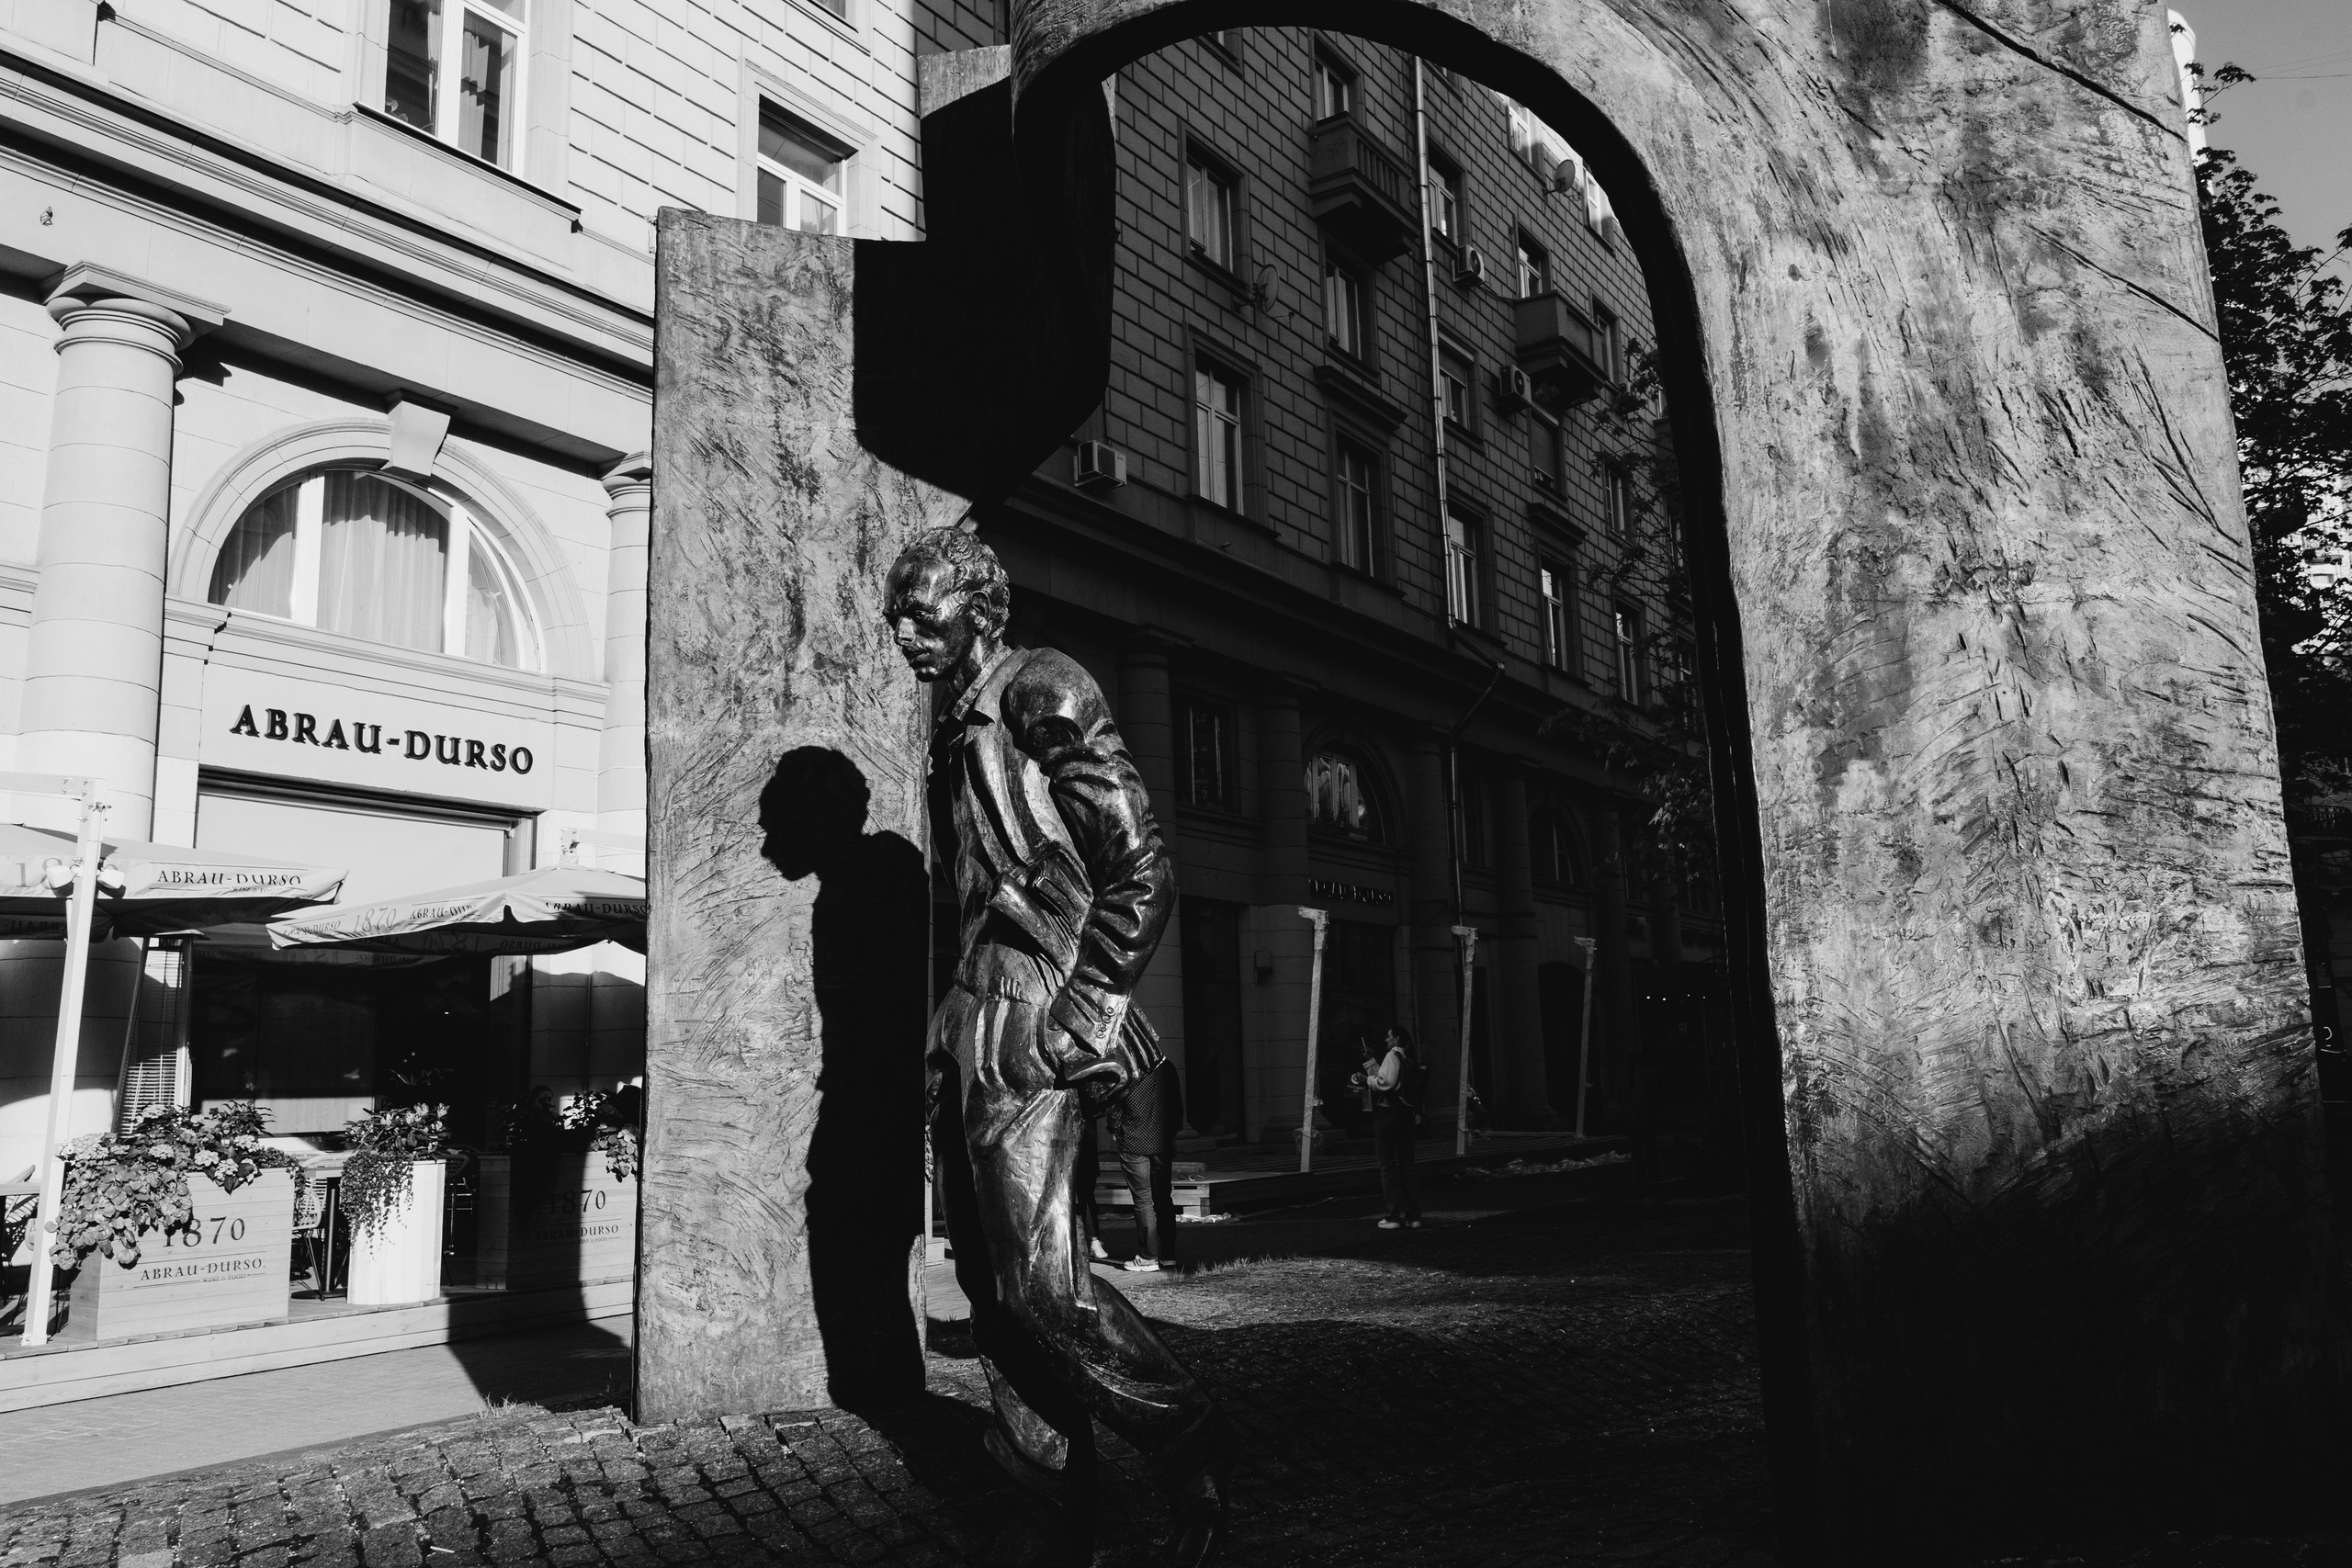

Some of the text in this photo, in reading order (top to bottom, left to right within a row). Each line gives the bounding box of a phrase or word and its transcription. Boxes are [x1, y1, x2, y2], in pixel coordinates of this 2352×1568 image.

[230, 704, 534, 774] ABRAU-DURSO
[157, 870, 301, 886] ABRAU-DURSO
[353, 906, 397, 933] 1870
[141, 1258, 263, 1280] ABRAU-DURSO
